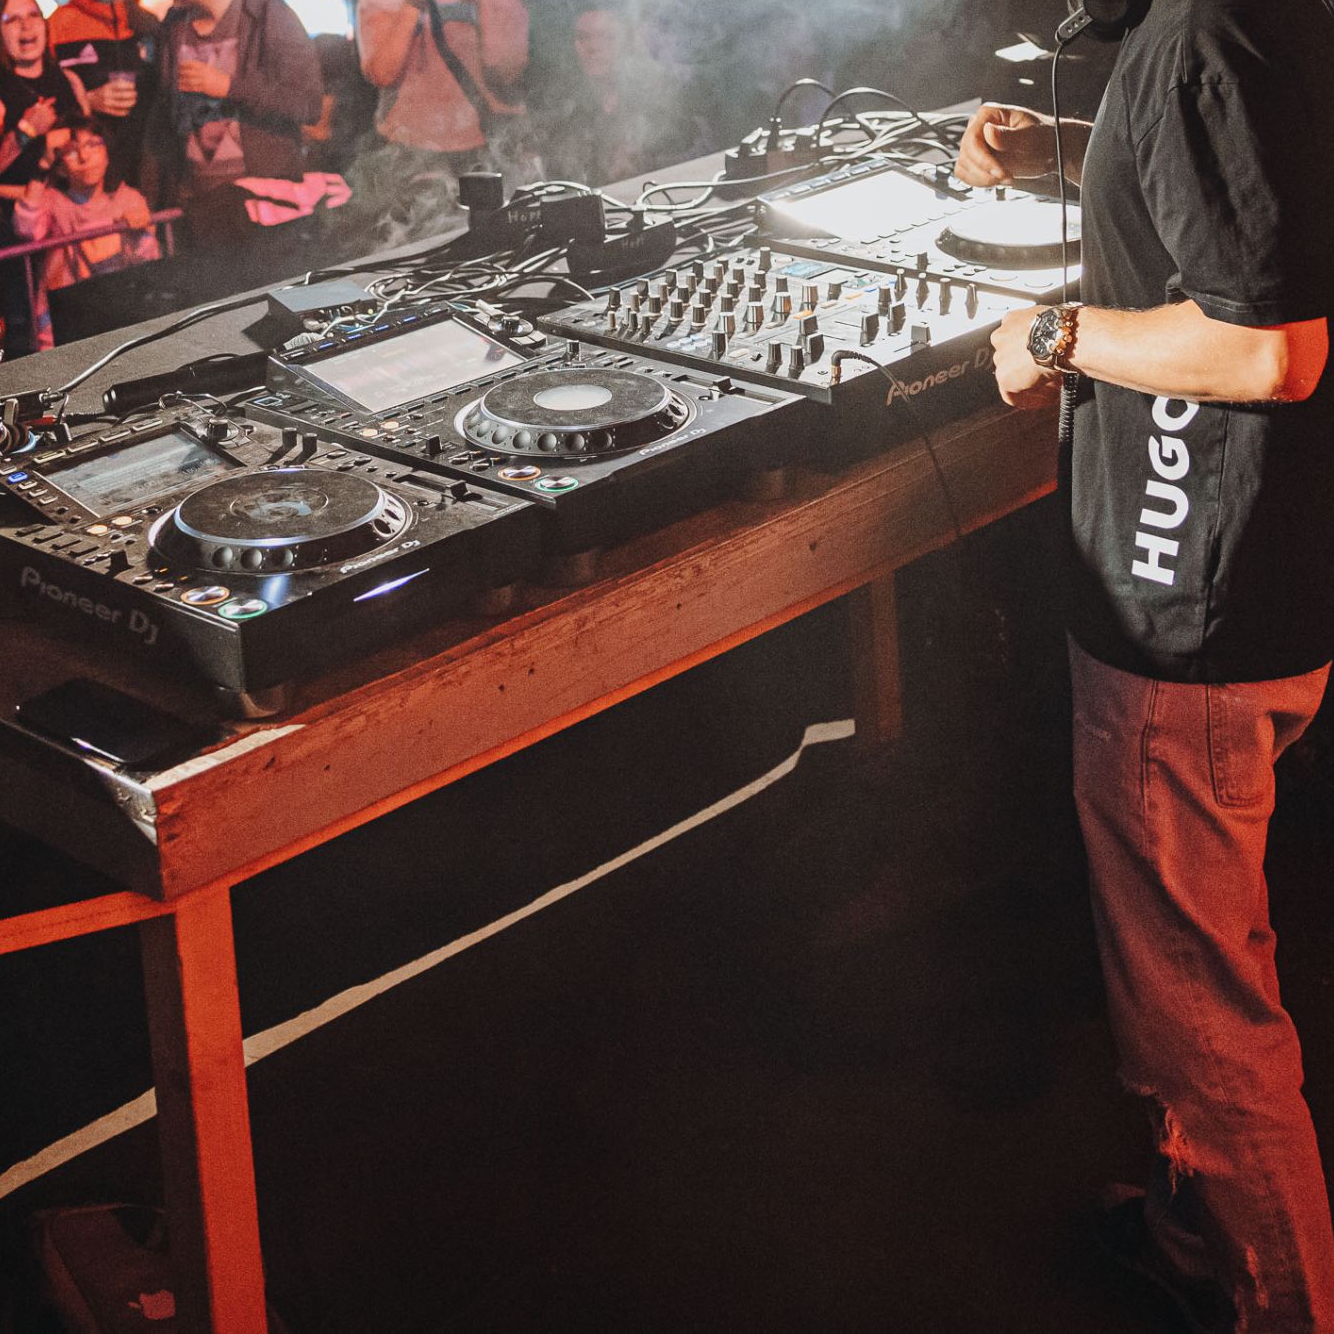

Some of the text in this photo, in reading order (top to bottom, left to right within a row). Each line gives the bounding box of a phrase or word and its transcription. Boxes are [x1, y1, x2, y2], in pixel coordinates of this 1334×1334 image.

[886, 361, 970, 406] Pioneer
[1131, 395, 1200, 586] HUGO
[21, 566, 159, 645] Pioneer DJ
